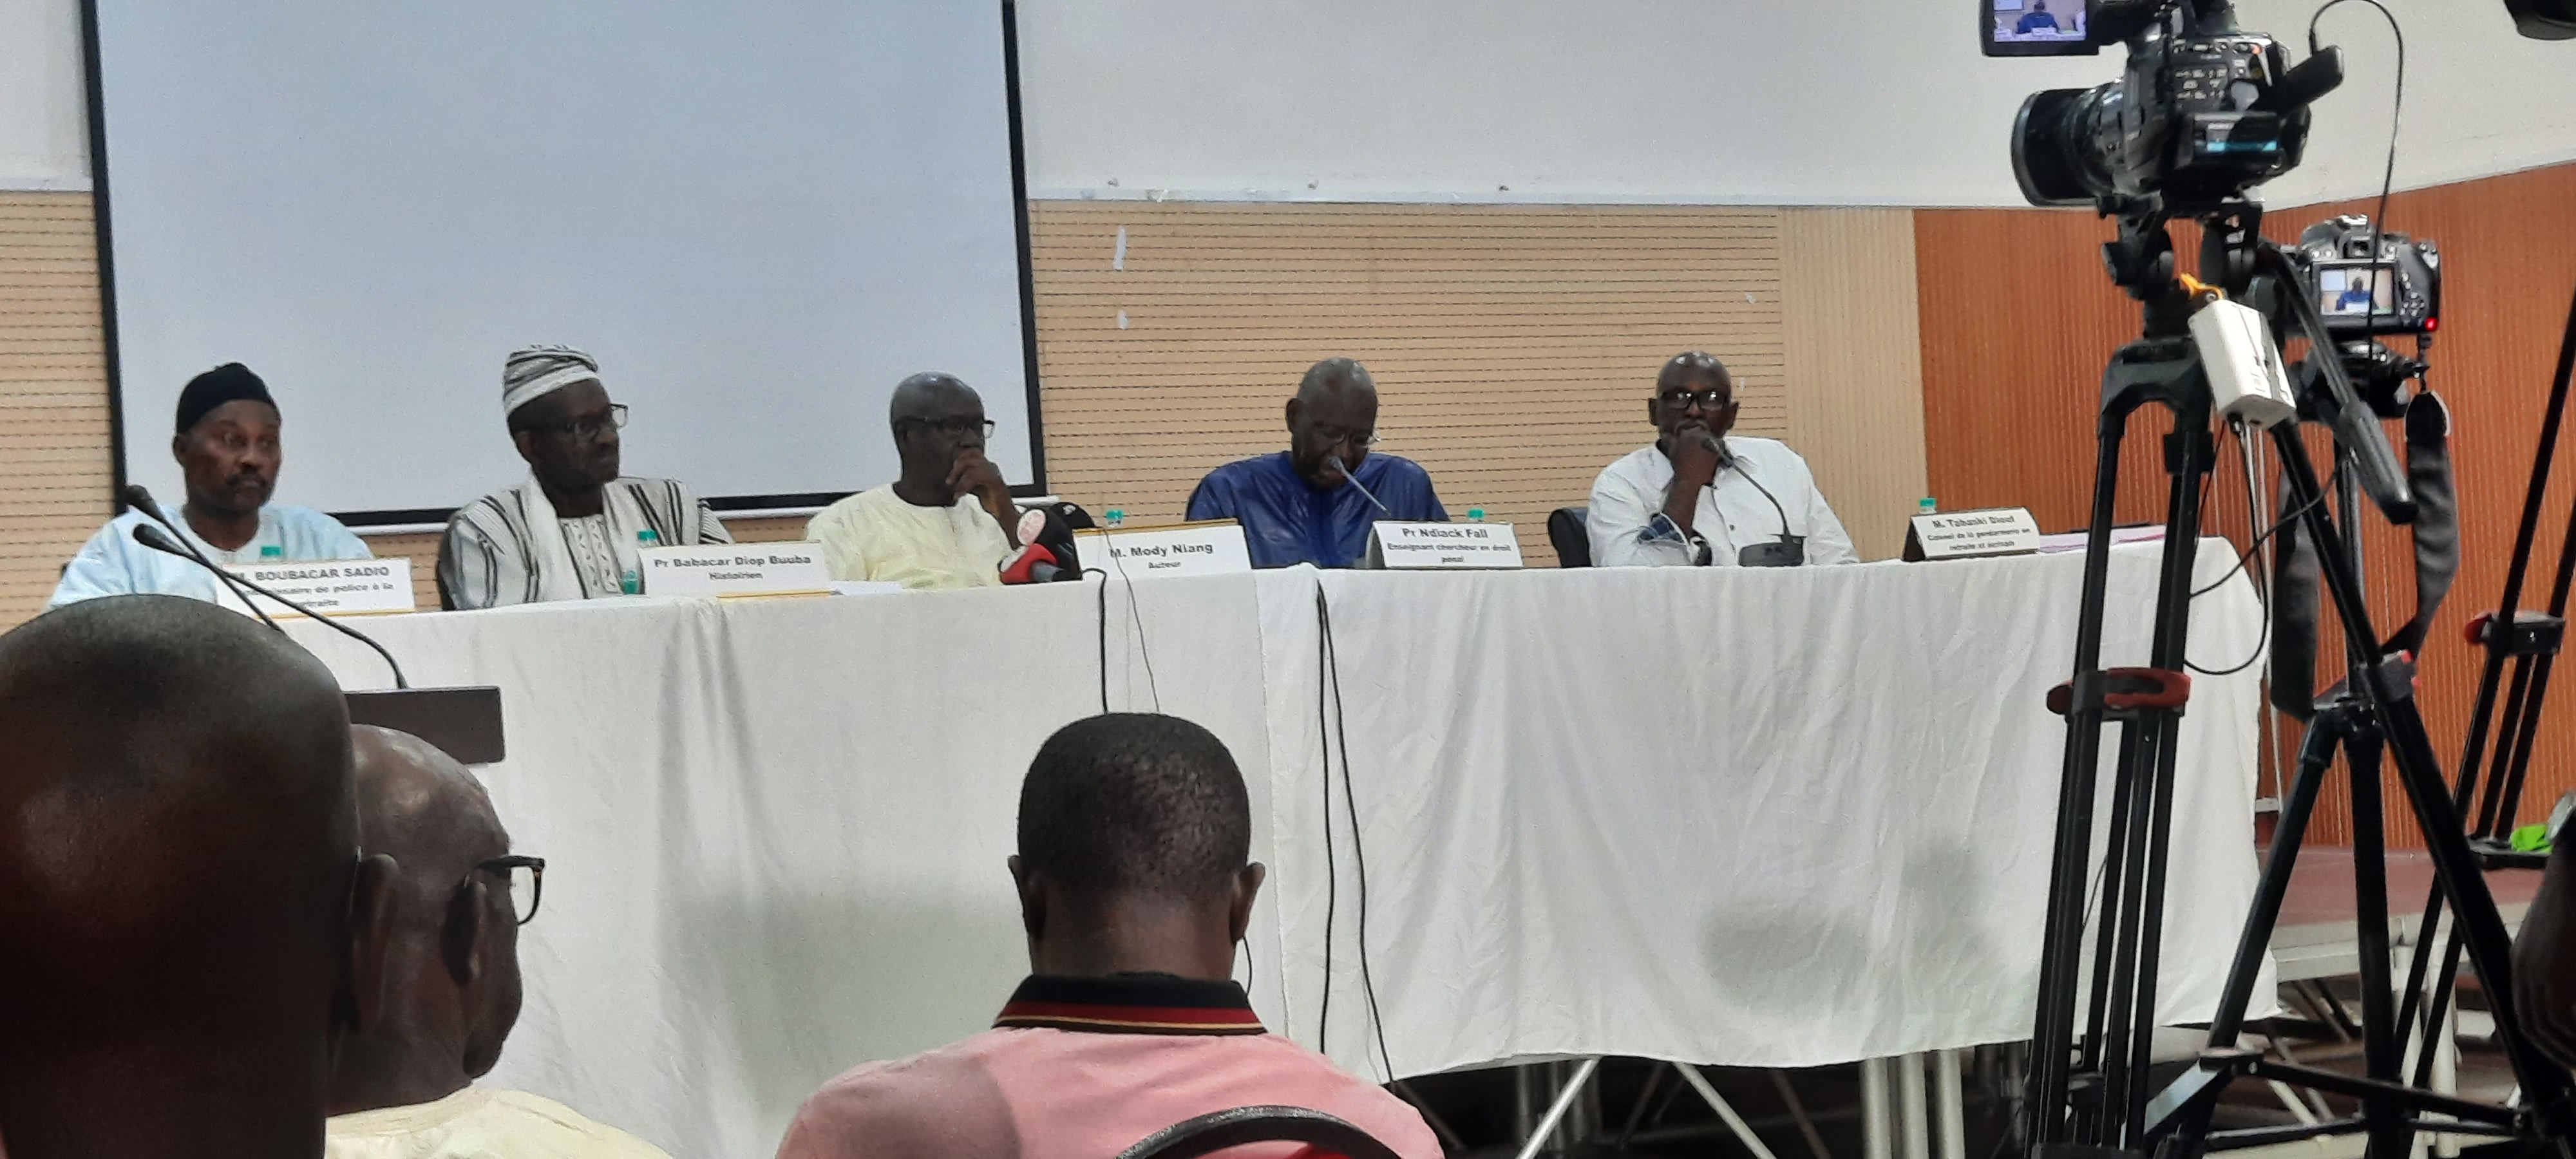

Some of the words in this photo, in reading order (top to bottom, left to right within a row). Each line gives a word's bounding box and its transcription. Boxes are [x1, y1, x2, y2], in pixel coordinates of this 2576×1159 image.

[1947, 517, 1988, 527] Tabaski
[1989, 515, 2015, 524] Diouf
[1402, 528, 1417, 537] Pr
[1419, 528, 1464, 538] Ndiack
[1466, 529, 1489, 538] Fall
[1110, 549, 1126, 558] M.
[1130, 545, 1168, 557] Mody
[1171, 543, 1213, 554] Niang
[654, 558, 668, 567] Pr
[674, 558, 731, 567] Babacar
[735, 556, 765, 567] Diop
[1148, 561, 1182, 569] Auteur
[255, 568, 340, 580] BOUBACAR
[345, 566, 390, 577] SADIO
[710, 571, 763, 580] Historien
[334, 584, 369, 592] police
